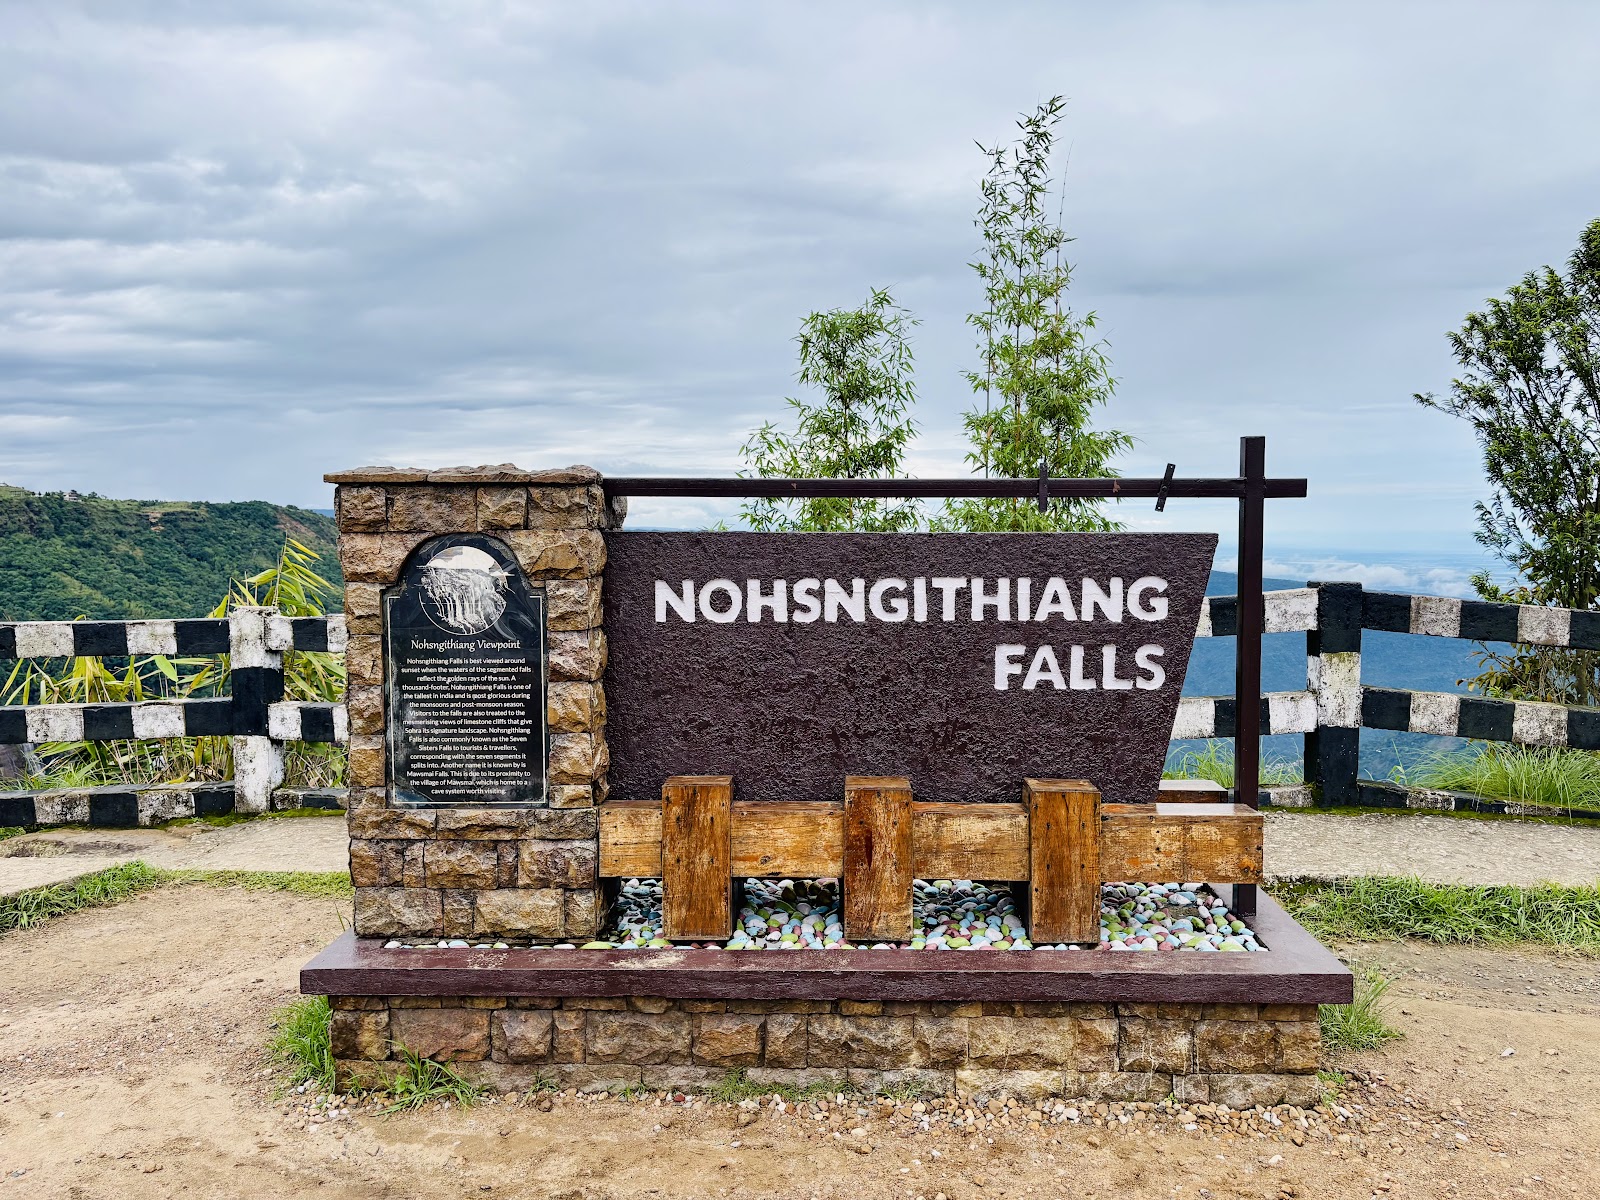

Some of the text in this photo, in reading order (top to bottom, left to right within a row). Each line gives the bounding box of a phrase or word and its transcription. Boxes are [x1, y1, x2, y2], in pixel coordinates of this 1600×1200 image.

[654, 577, 1169, 623] NOHSNGITHIANG
[411, 640, 520, 652] Nohsngithiang Viewpoint
[994, 644, 1166, 691] FALLS
